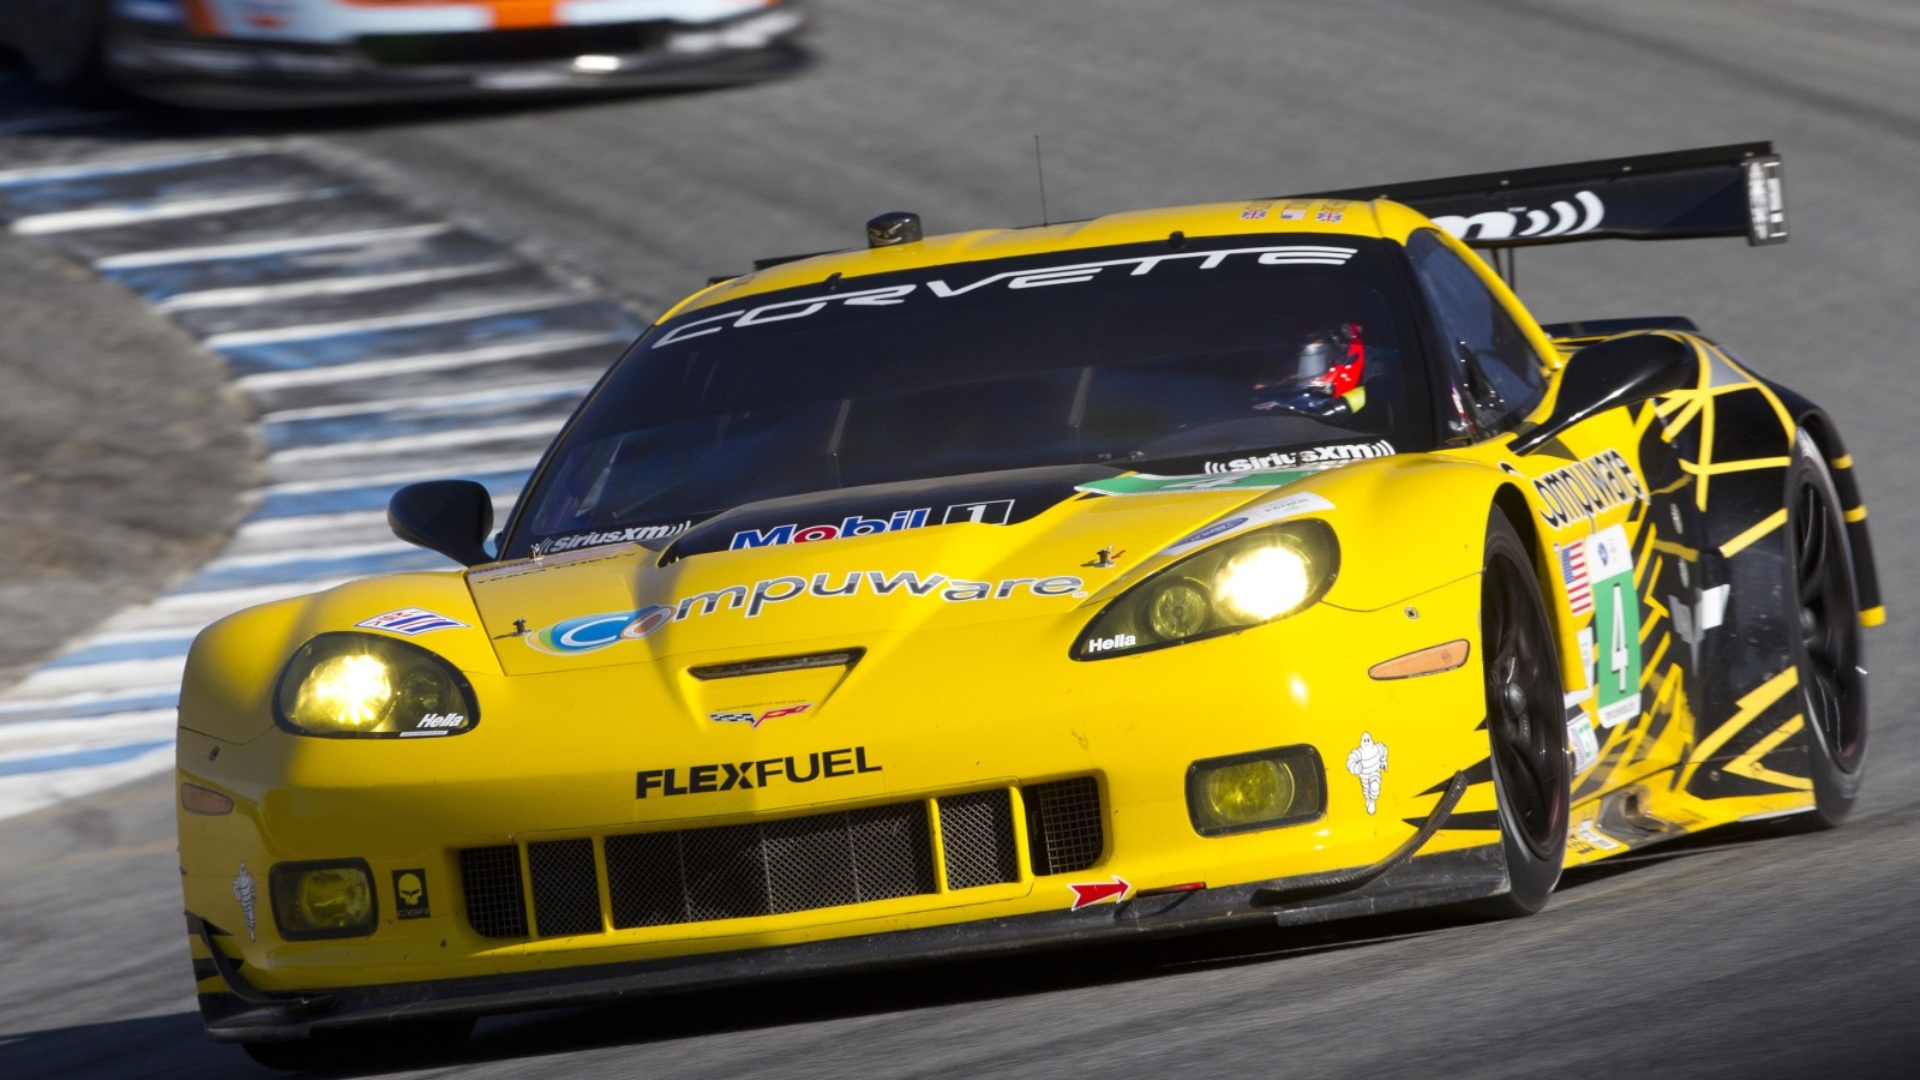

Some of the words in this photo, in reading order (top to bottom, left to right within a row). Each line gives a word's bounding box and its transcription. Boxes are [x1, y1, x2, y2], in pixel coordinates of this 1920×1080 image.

[651, 246, 1358, 349] CORVETTE
[728, 507, 931, 551] Mobil
[558, 570, 1083, 648] Compuware
[1088, 634, 1136, 653] Hella
[1610, 582, 1630, 694] 4
[416, 712, 464, 729] Hella
[635, 745, 883, 800] FLEXFUEL
